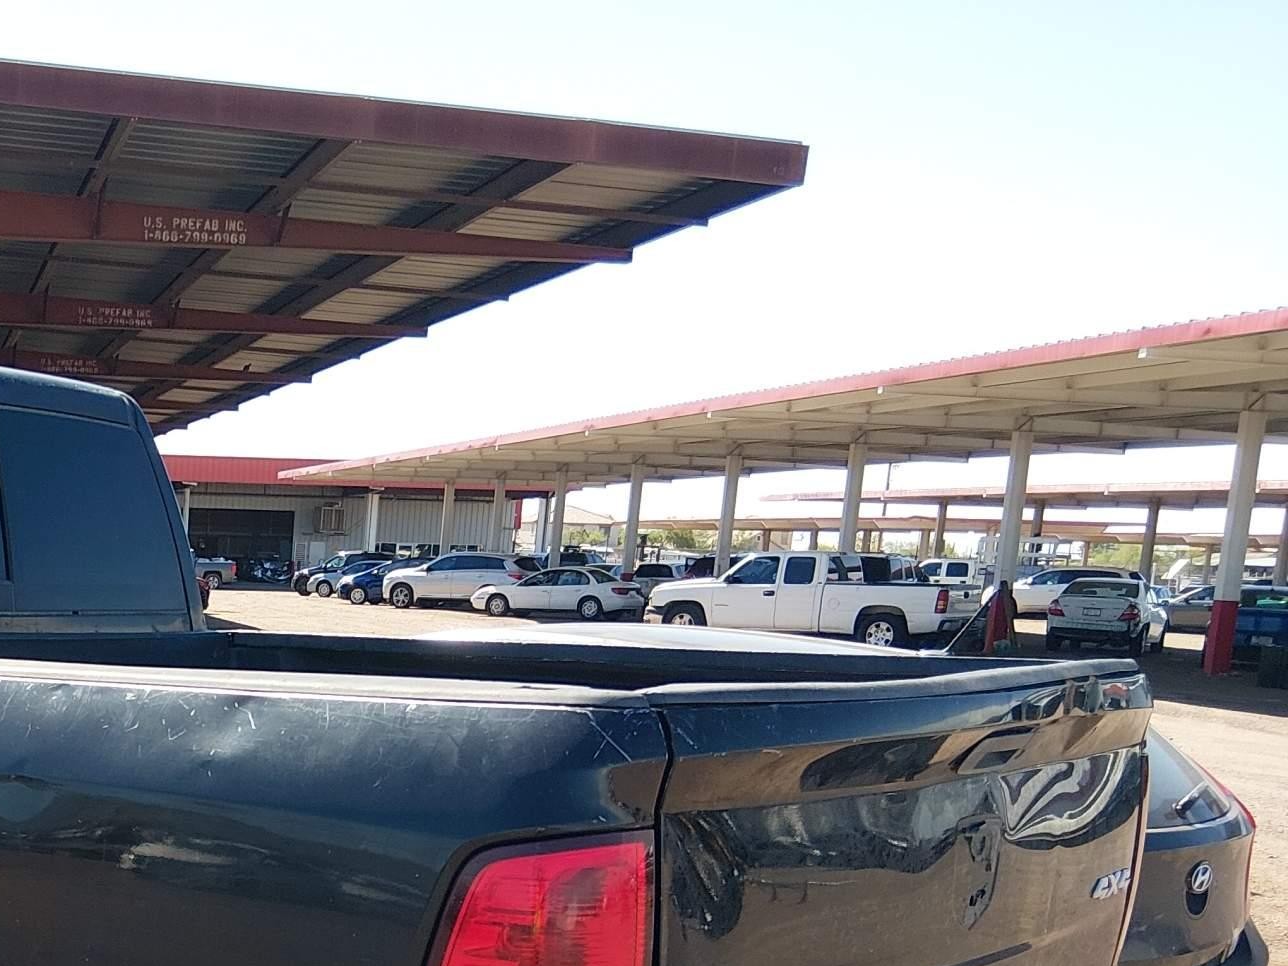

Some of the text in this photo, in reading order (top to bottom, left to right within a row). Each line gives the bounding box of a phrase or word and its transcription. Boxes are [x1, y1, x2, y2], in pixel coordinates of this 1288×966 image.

[143, 216, 248, 232] U.S. PREFAB INC.
